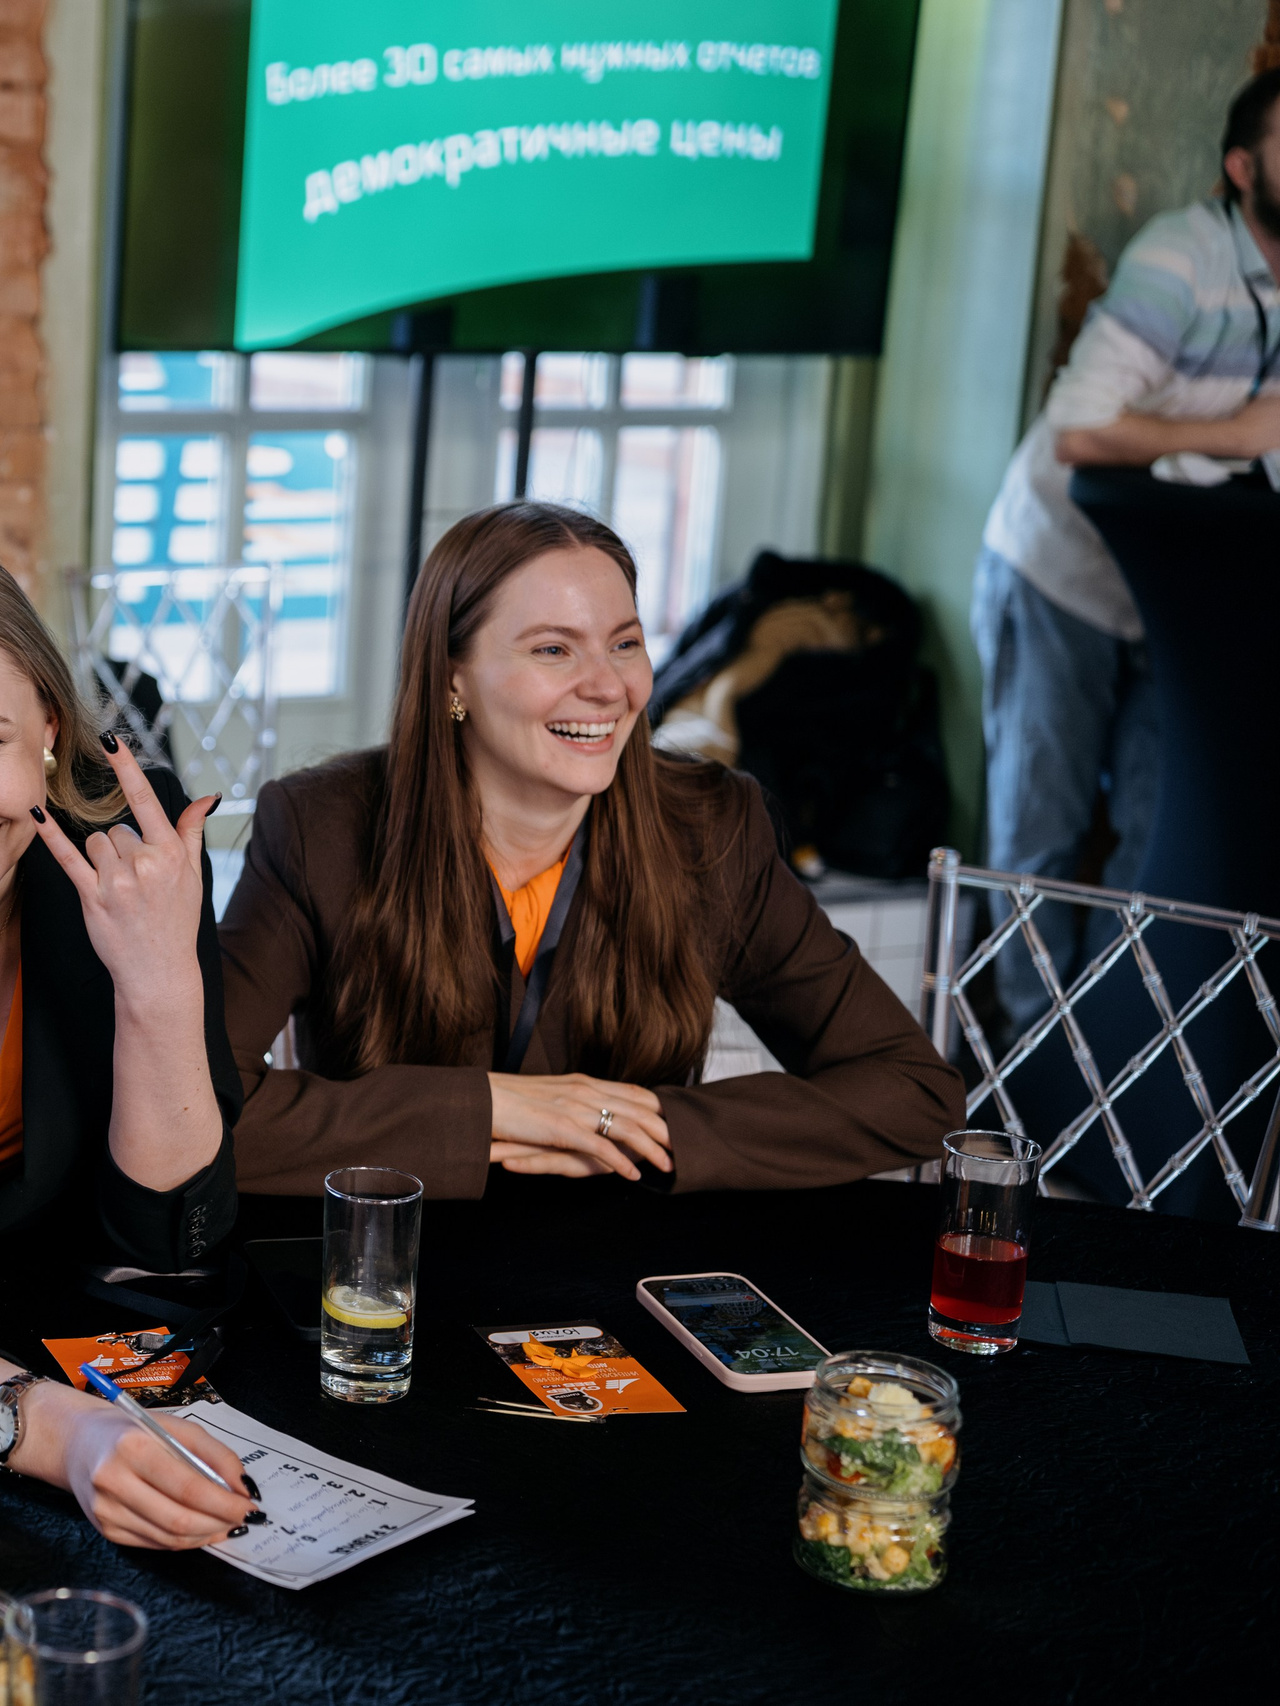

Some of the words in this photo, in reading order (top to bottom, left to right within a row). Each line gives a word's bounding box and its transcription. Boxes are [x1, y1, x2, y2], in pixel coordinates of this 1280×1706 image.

[266, 57, 378, 105] Более
[383, 42, 438, 88] 30
[443, 43, 556, 82] самых
[561, 40, 692, 84] нужных
[696, 40, 821, 79] отчетов
[303, 118, 661, 223] демократичные
[670, 120, 784, 162] цены
[735, 1346, 799, 1359] 17:04
[240, 1449, 269, 1467] КОМ
